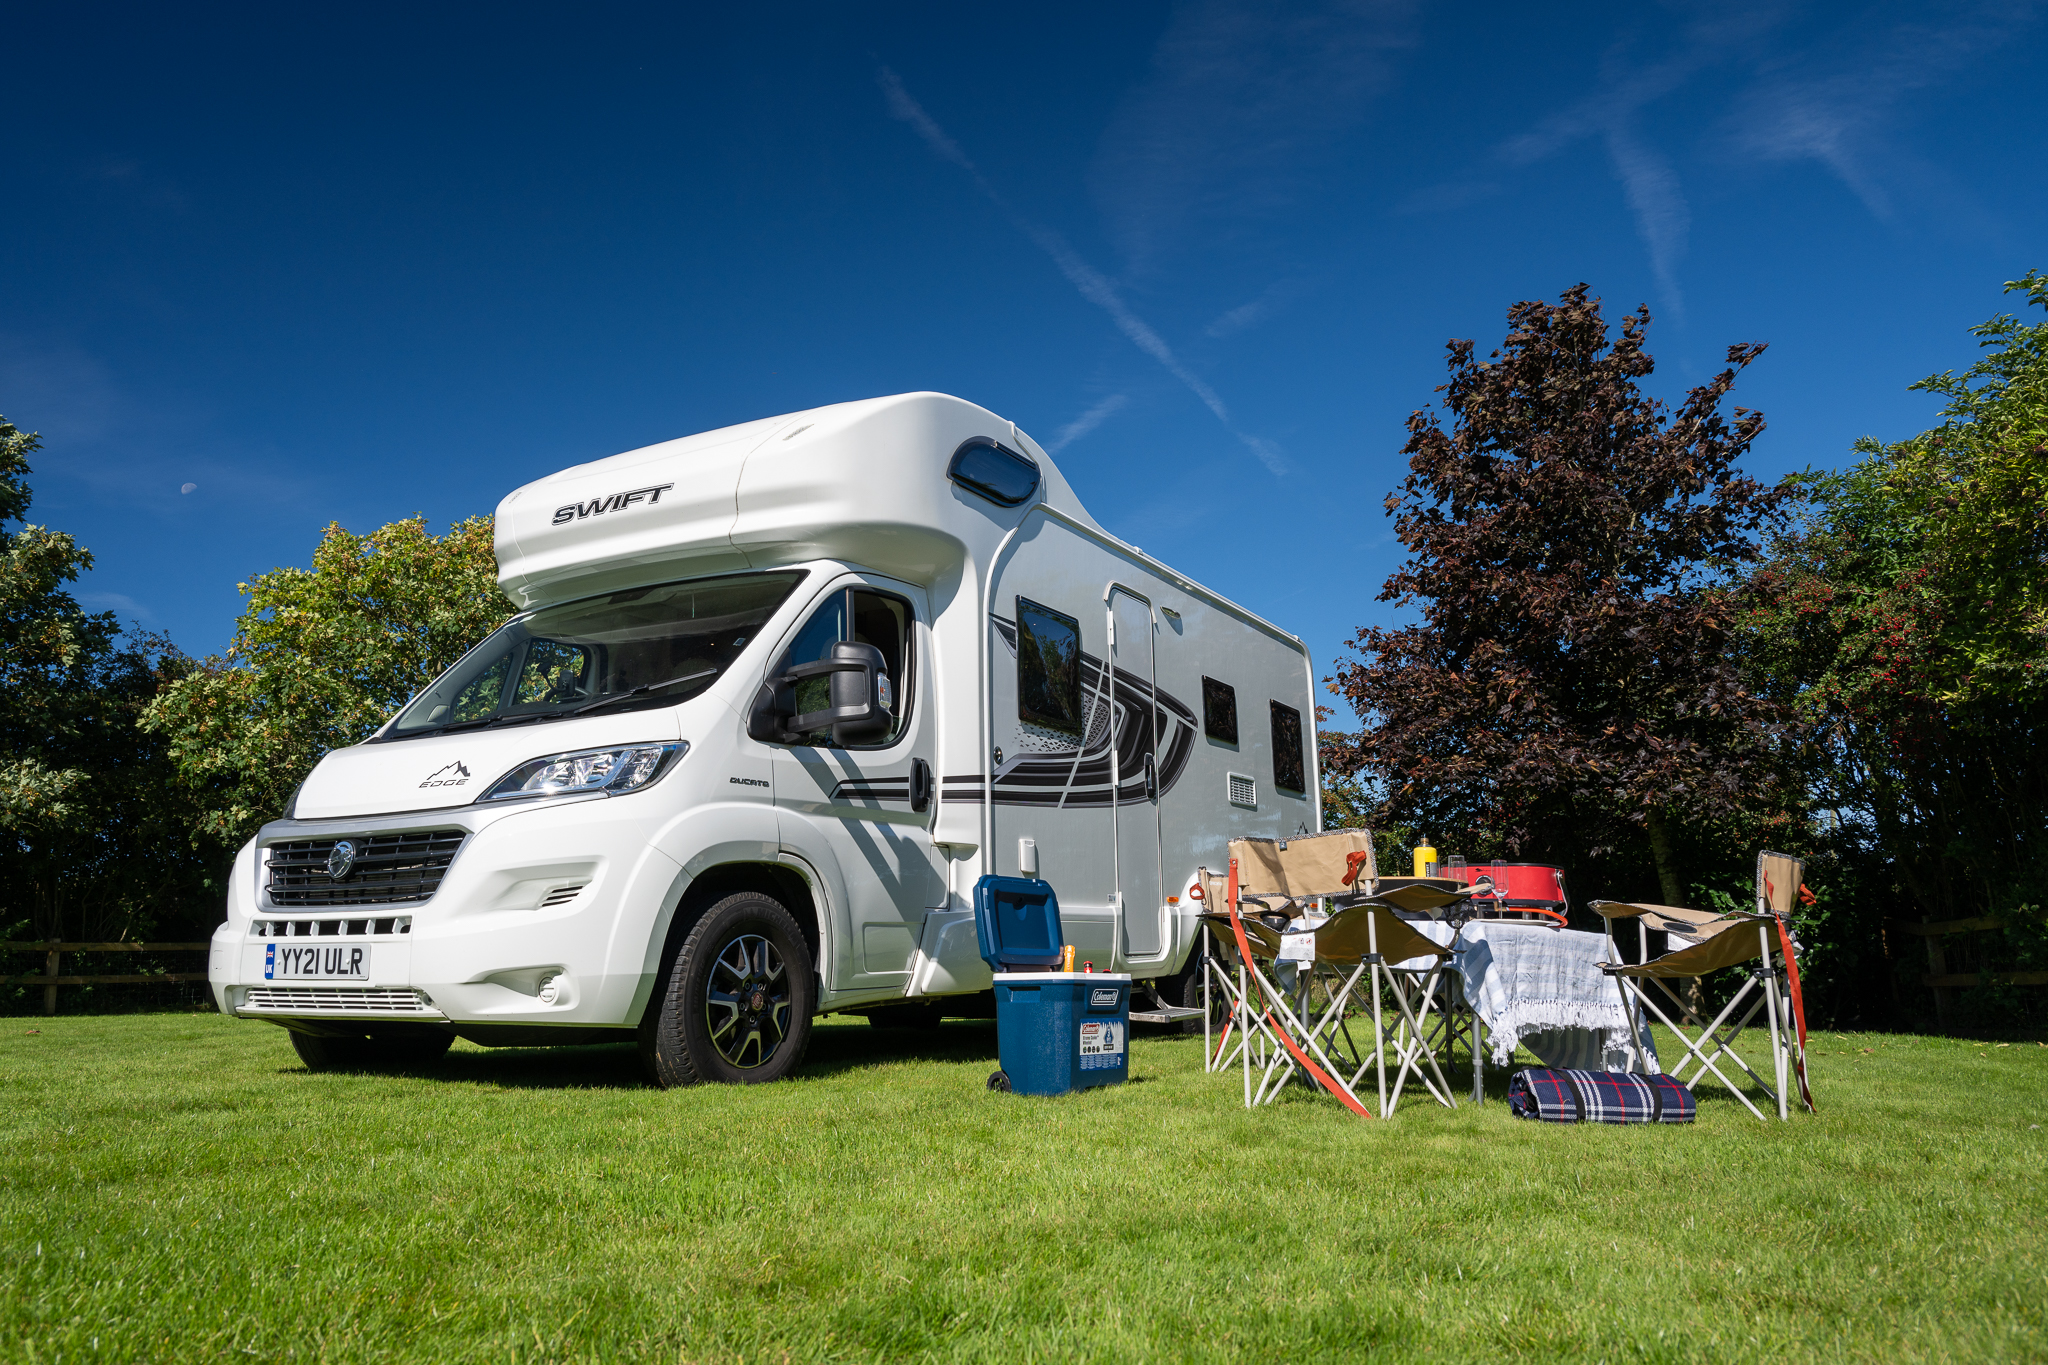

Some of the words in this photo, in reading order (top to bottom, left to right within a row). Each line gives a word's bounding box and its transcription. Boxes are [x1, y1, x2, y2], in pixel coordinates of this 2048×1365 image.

[552, 482, 675, 526] SWIFT
[418, 778, 469, 788] EDGE
[729, 776, 770, 788] DUCATO
[282, 948, 320, 974] YY21
[325, 948, 363, 975] ULR
[265, 964, 273, 974] UK
[1093, 991, 1115, 1001] Coleman
